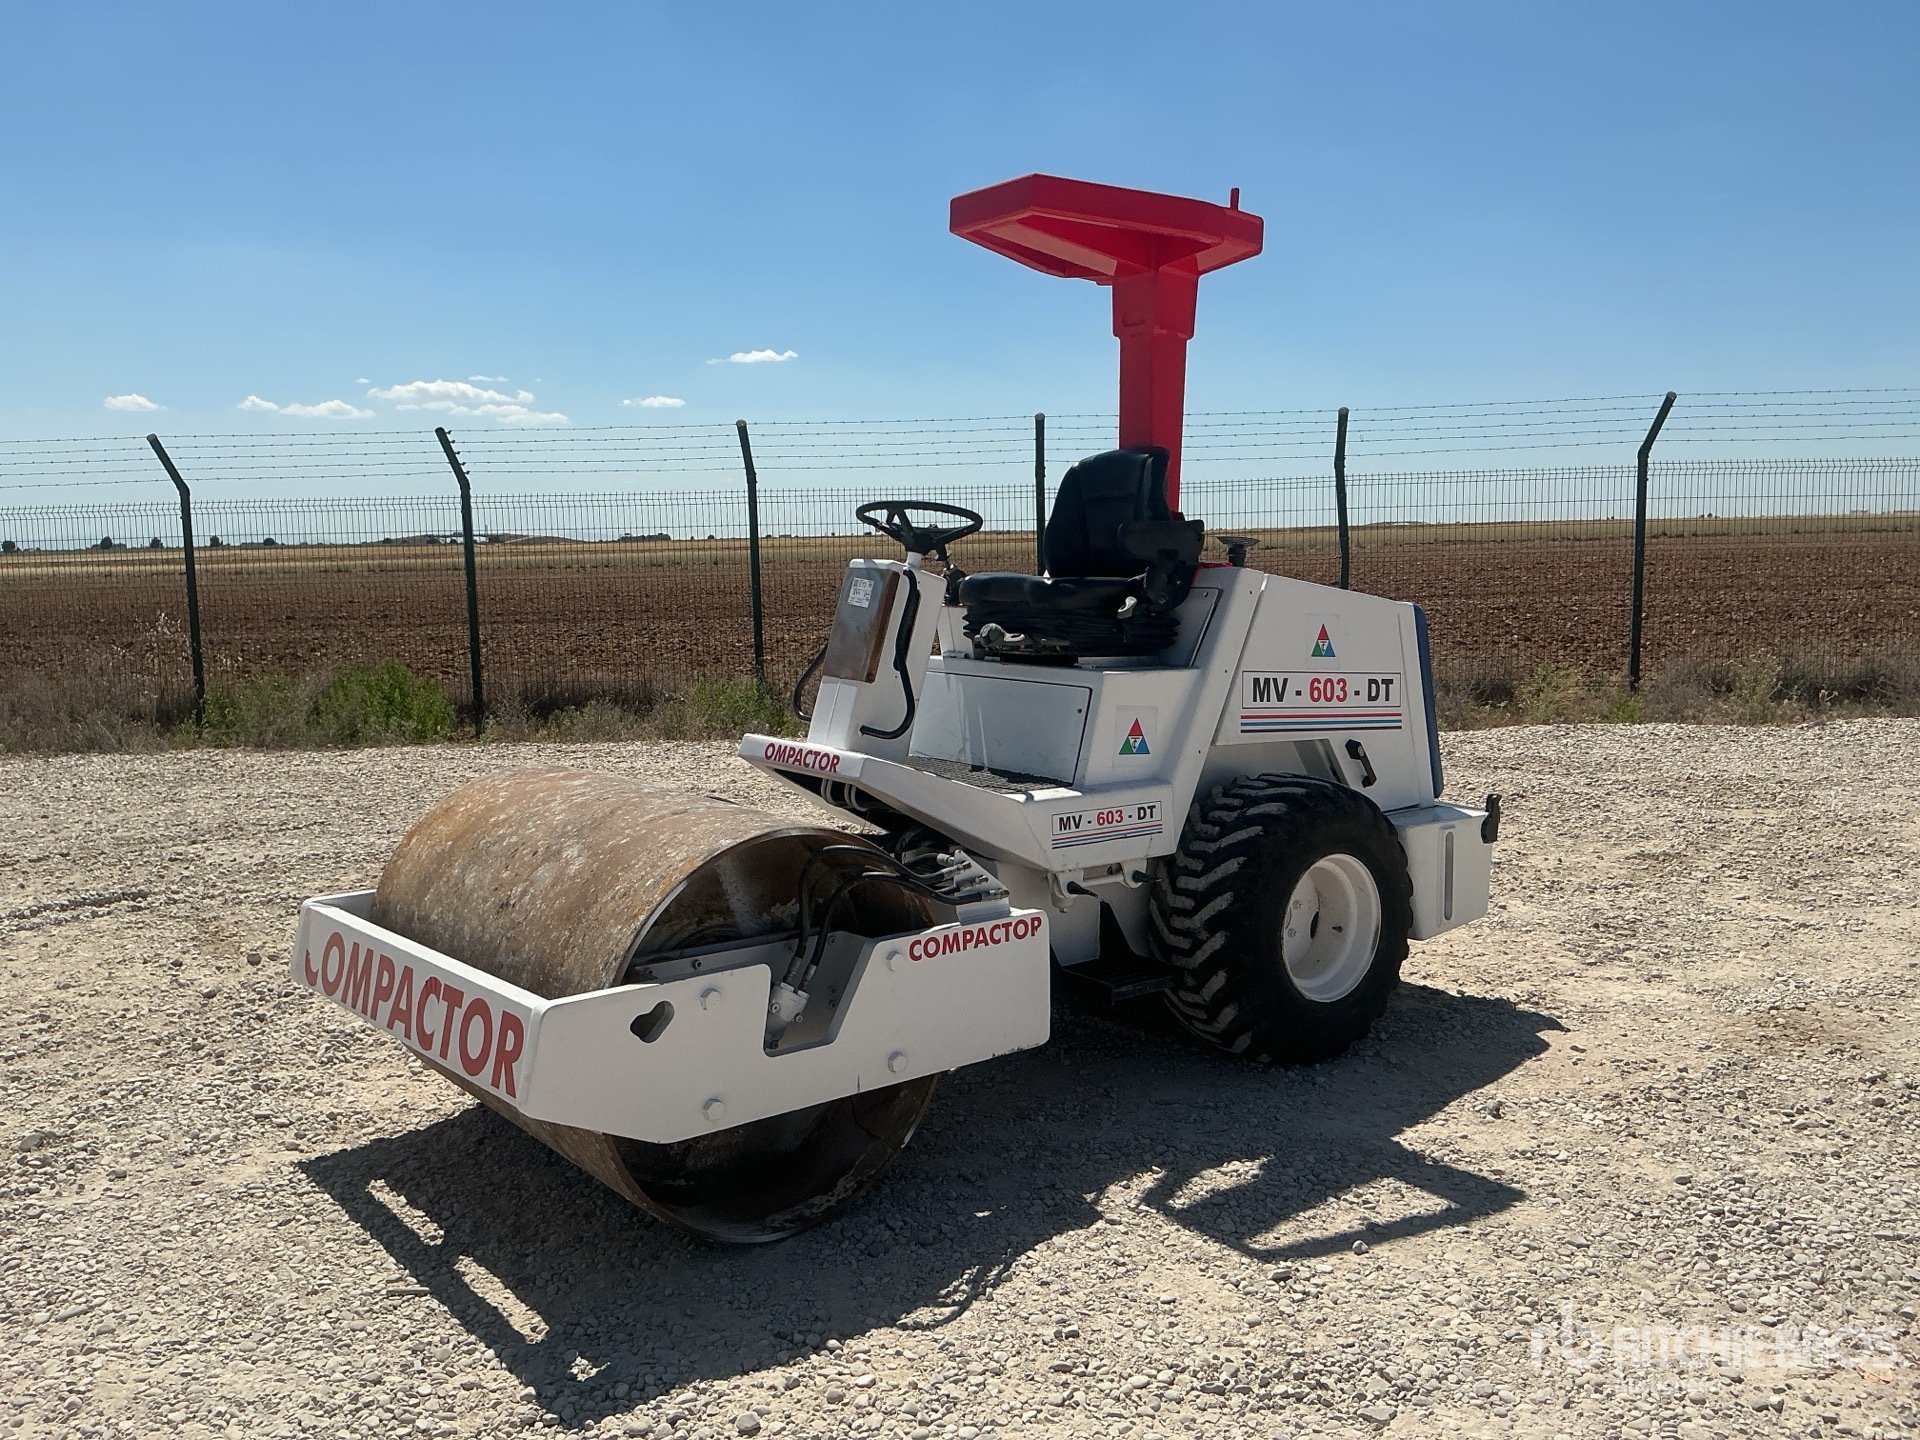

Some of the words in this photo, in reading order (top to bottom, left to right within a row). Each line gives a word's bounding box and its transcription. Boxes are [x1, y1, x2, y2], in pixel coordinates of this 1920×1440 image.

[1252, 677, 1289, 703] MV
[1309, 677, 1347, 703] 603
[1367, 678, 1394, 702] DT
[1058, 814, 1083, 832] MV
[1096, 809, 1124, 827] 603
[1137, 804, 1157, 821] DT
